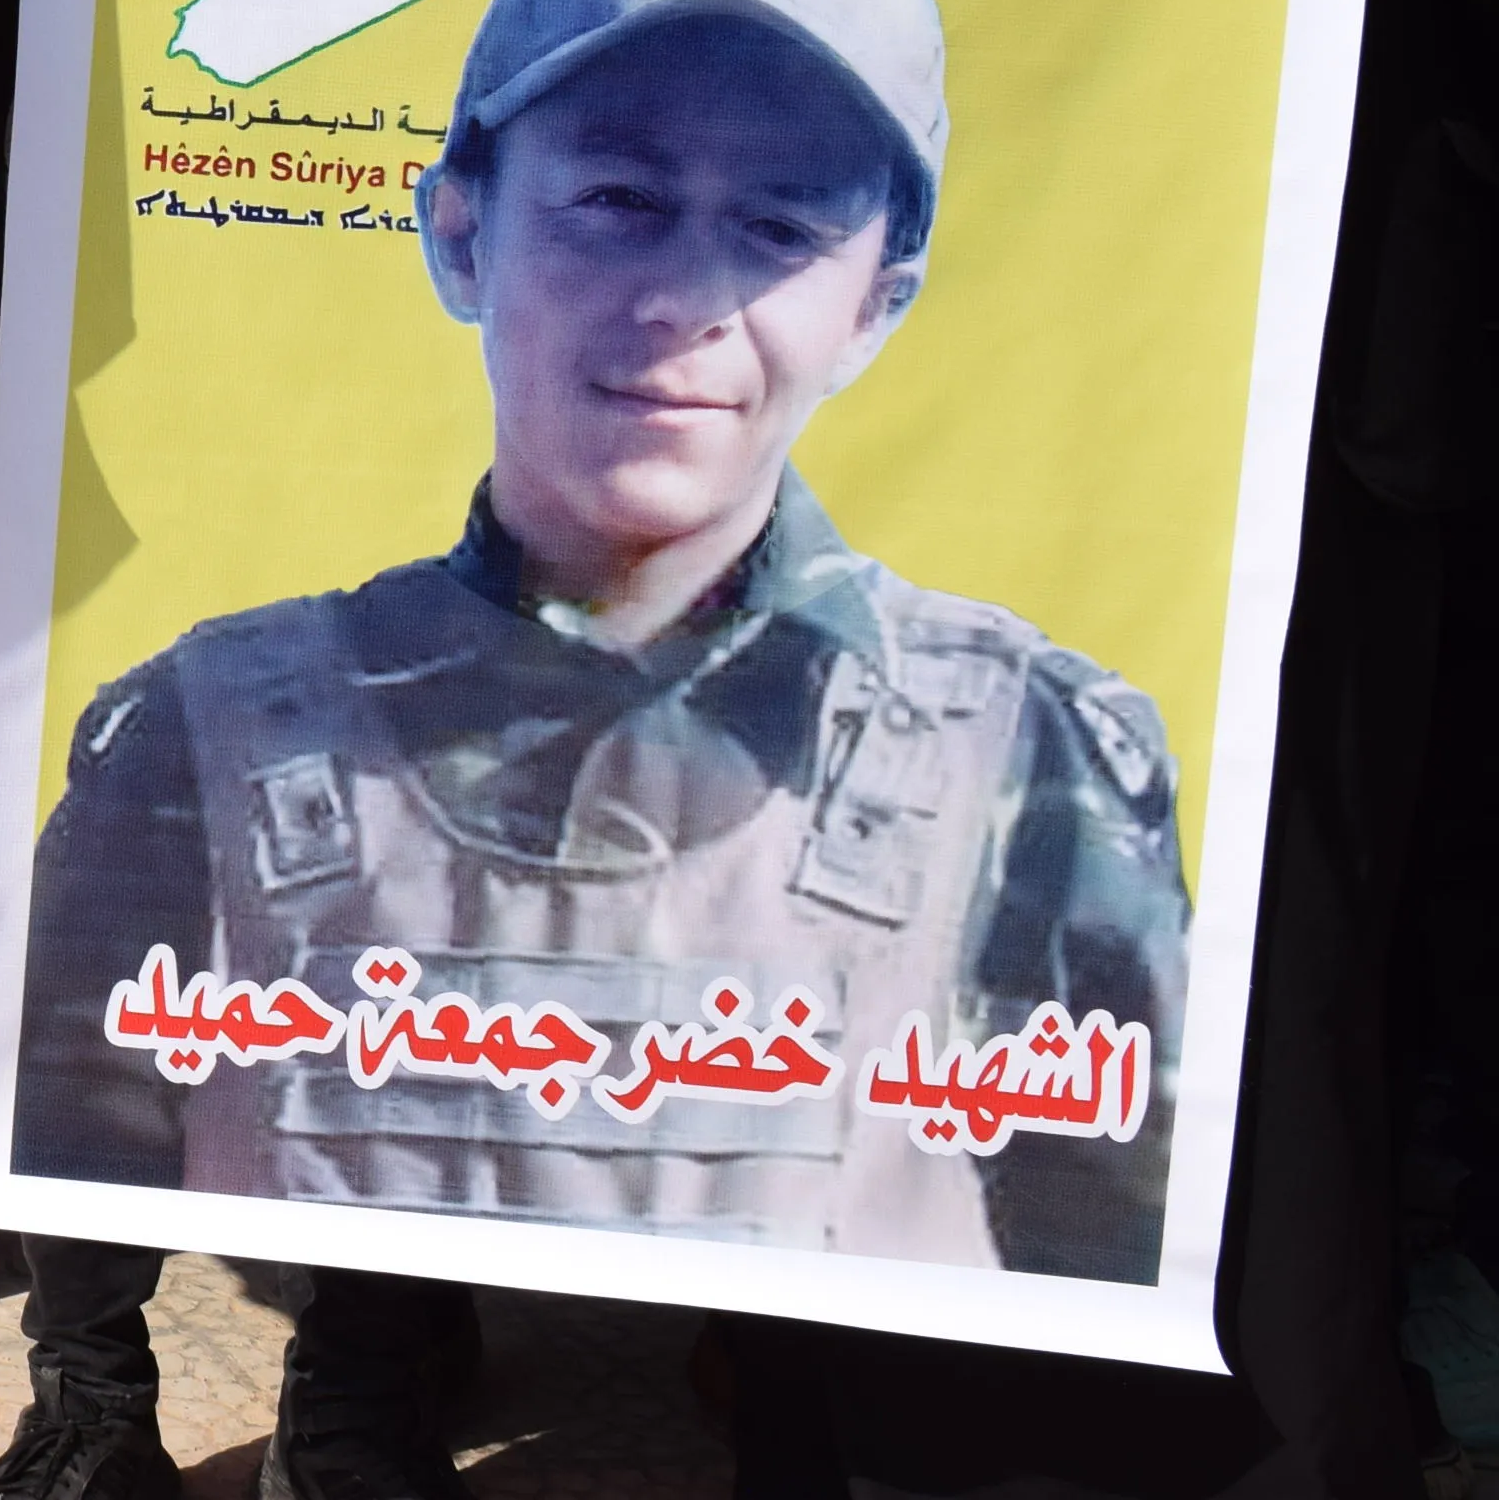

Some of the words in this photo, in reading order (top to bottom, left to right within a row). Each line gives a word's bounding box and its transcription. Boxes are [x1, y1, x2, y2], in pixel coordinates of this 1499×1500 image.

[140, 86, 385, 136] الديمقراطية
[144, 143, 257, 180] Hêzên
[270, 151, 386, 195] Sûriya
[113, 953, 338, 1075] حميد
[355, 956, 597, 1110] جمعة
[606, 985, 835, 1114] خضر
[867, 1011, 1143, 1145] الشهيد
